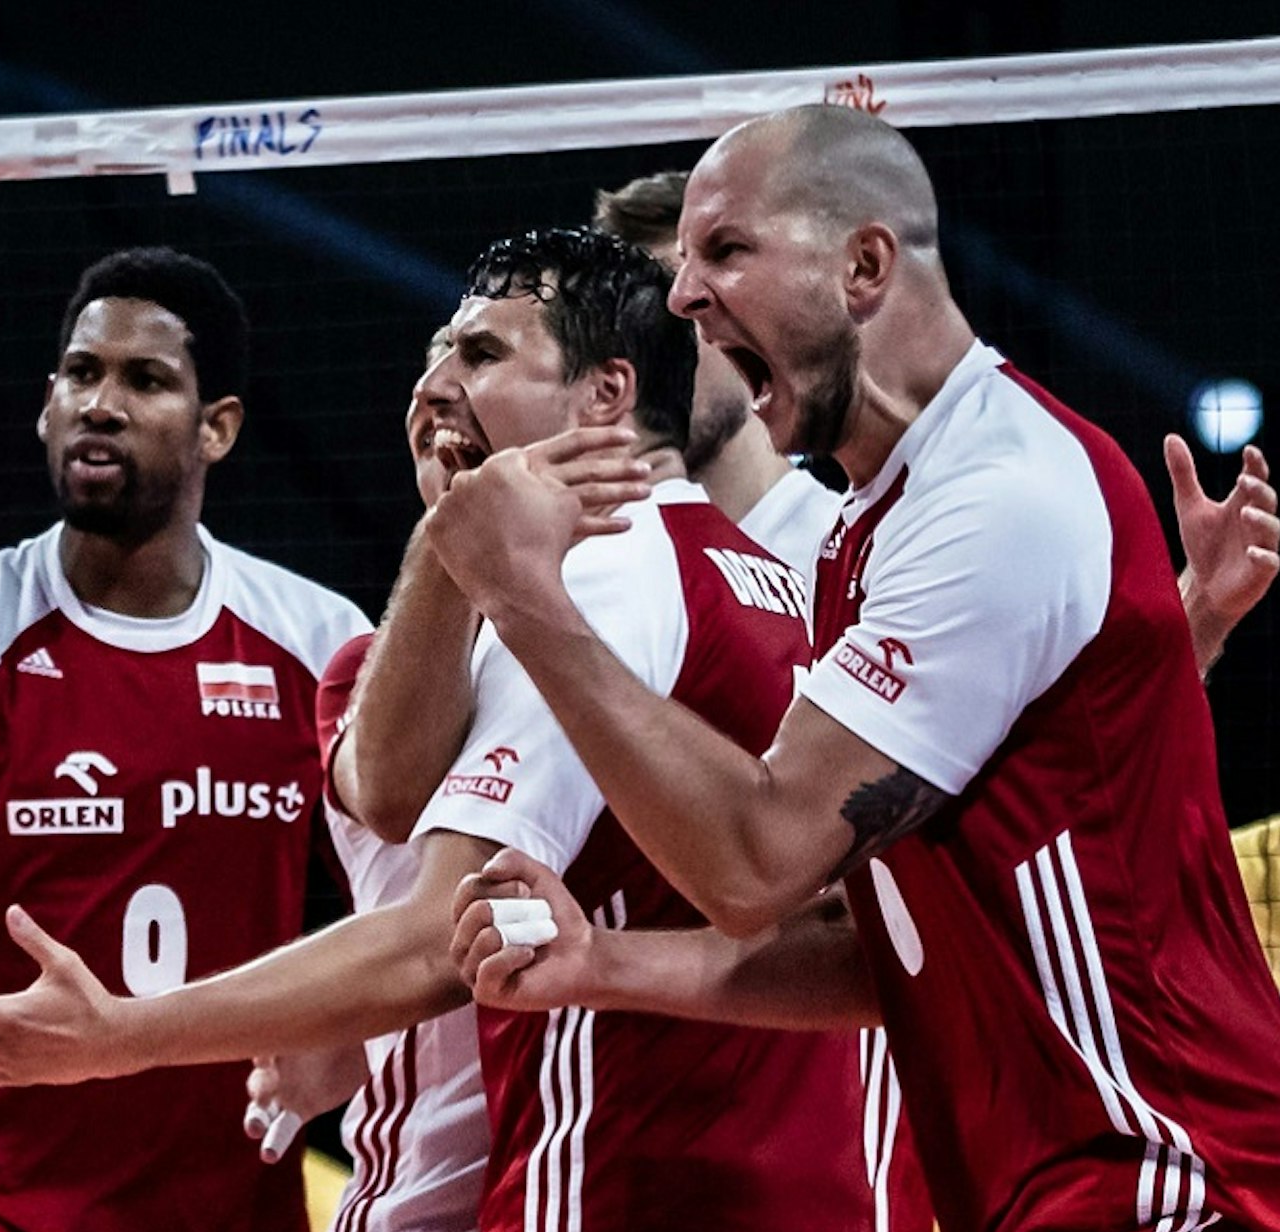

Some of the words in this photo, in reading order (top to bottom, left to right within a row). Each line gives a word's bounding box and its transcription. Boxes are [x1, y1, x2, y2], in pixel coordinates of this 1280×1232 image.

[195, 109, 322, 159] FINALS
[836, 645, 900, 700] ORLEN
[201, 699, 282, 720] POLSKA
[15, 805, 115, 829] ORLEN
